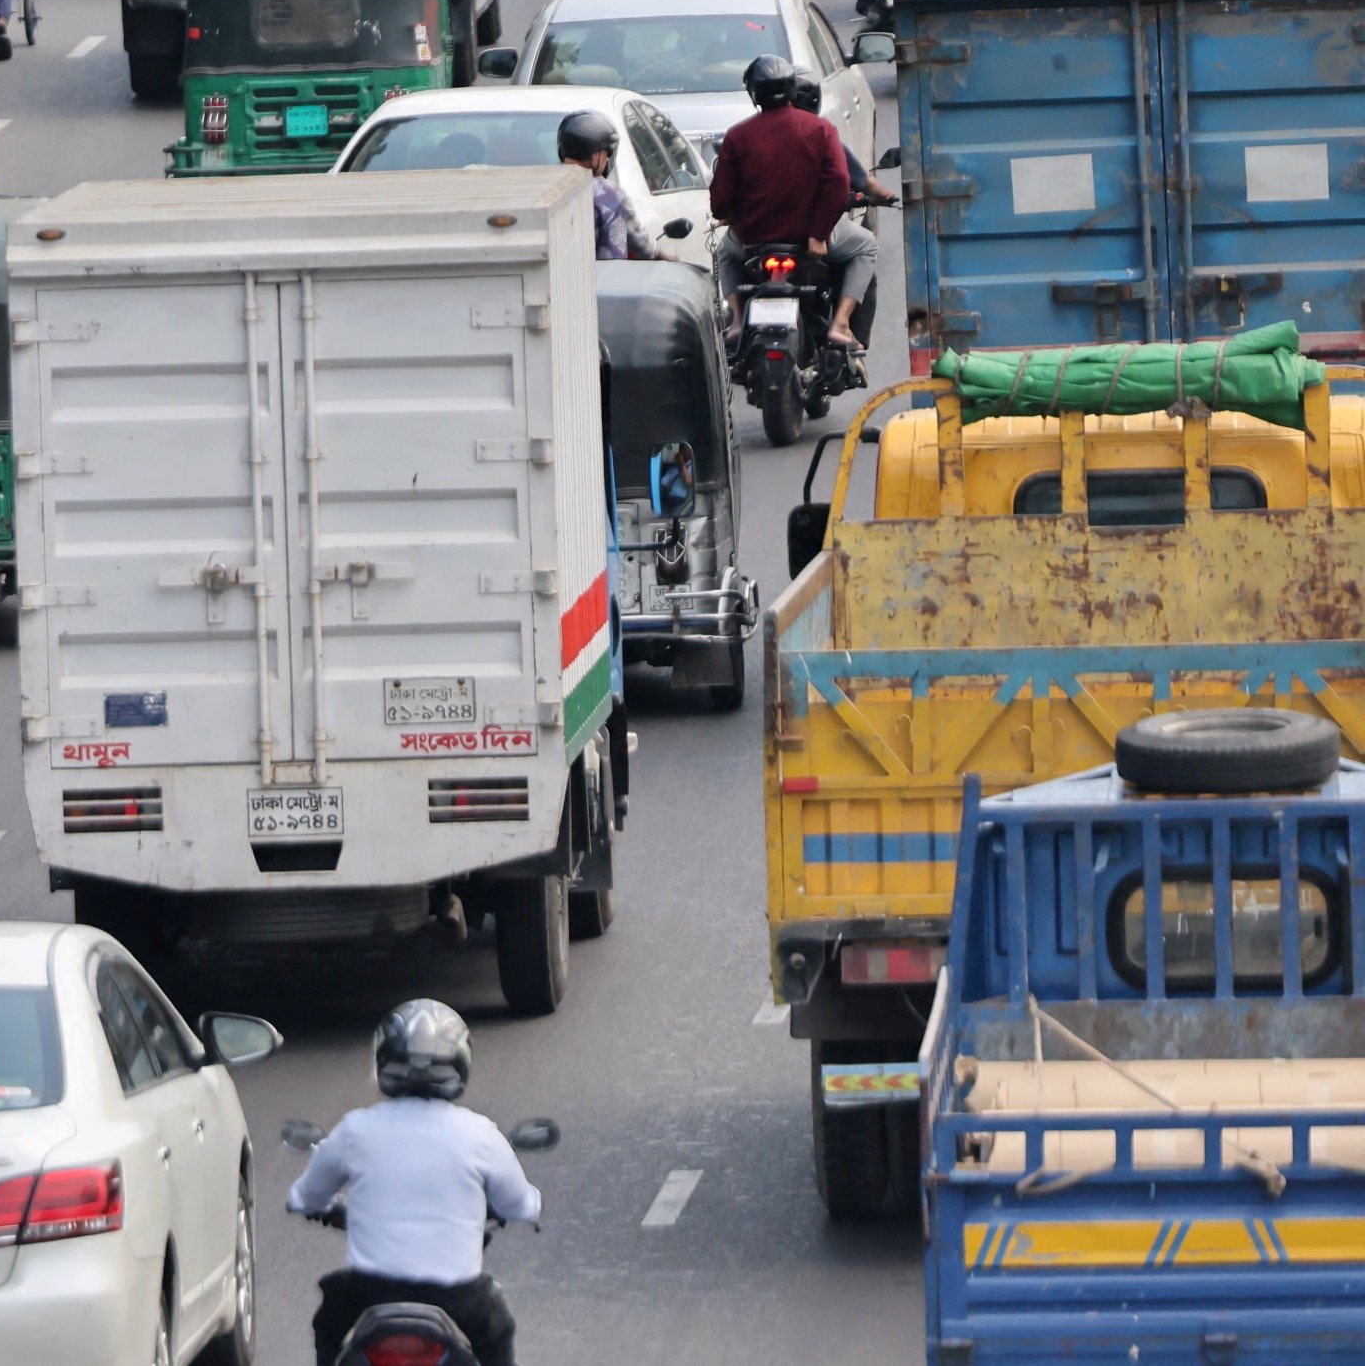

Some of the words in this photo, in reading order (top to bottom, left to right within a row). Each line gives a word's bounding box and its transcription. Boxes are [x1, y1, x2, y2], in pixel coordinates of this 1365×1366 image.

[389, 689, 416, 700] ঢাকা
[387, 703, 472, 722] ৫১-৯৭৪৪
[400, 732, 477, 752] সংকেত
[480, 724, 533, 751] দিন
[63, 742, 133, 769] থামুন
[251, 795, 284, 810] ঢাকা
[253, 813, 339, 830] ৫১-৯৭৪৪
